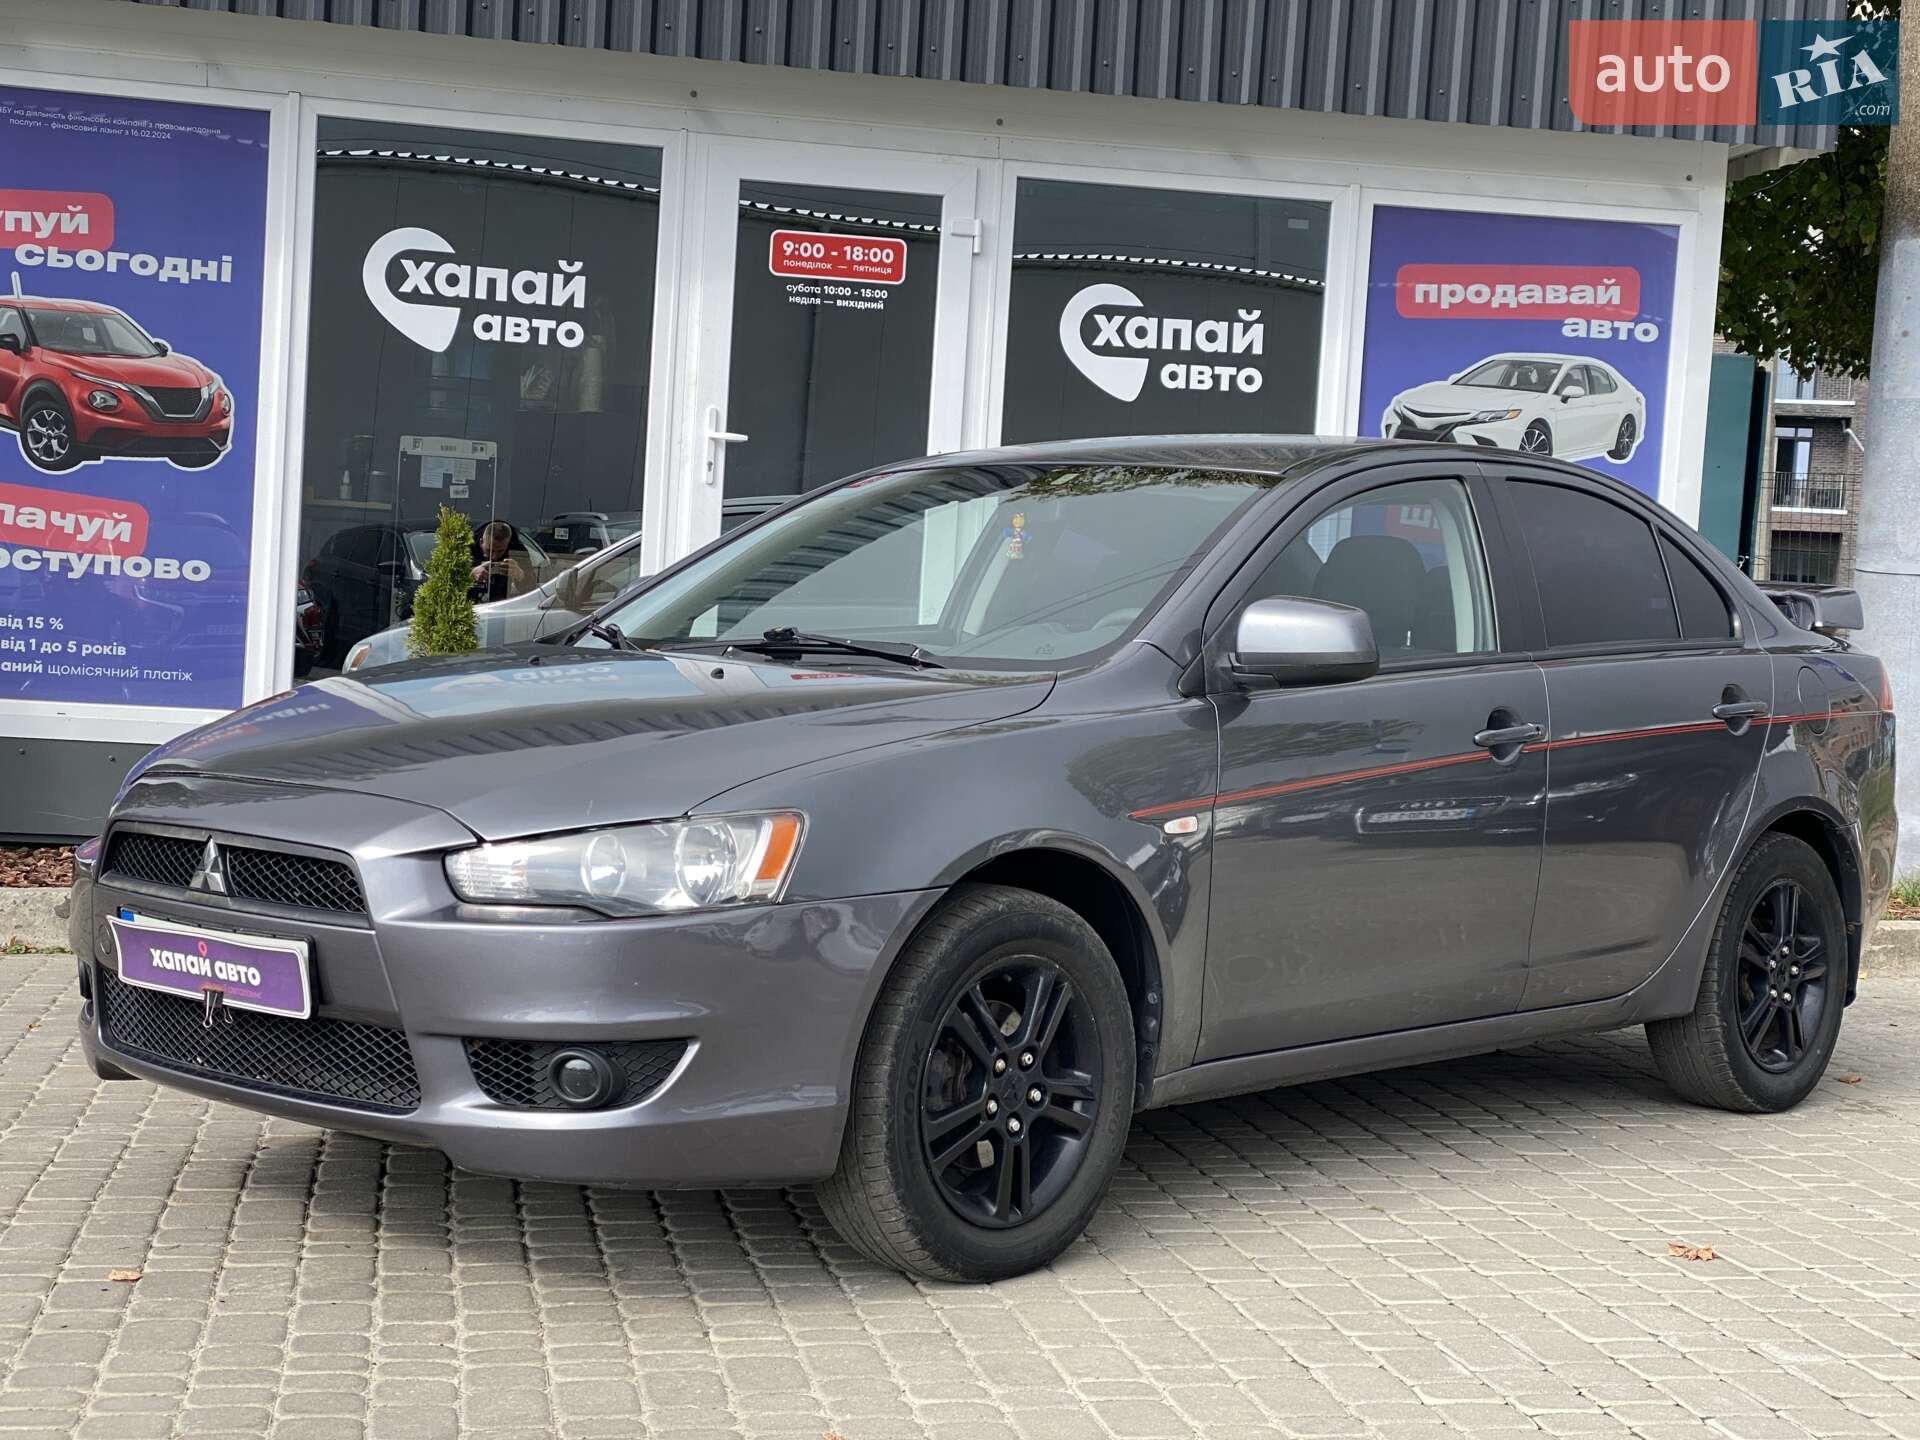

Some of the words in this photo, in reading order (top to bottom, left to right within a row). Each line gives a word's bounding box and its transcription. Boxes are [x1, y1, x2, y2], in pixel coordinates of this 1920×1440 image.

[0, 205, 89, 239] пуй
[15, 243, 233, 284] сьогодні
[782, 241, 825, 258] 9:00
[843, 245, 894, 264] 18:00
[783, 259, 833, 270] понеділок
[398, 259, 586, 308] хапай
[786, 284, 821, 296] субота
[823, 285, 851, 296] 10:00
[861, 288, 888, 299] 15:00
[1415, 278, 1621, 309] продавай
[789, 295, 821, 305] неділя
[836, 299, 884, 310] вихідний
[473, 313, 584, 348] авто
[1092, 309, 1264, 355] хапай
[1561, 317, 1659, 342] авто
[1160, 363, 1263, 393] авто
[27, 616, 44, 629] 15
[1, 637, 25, 652] від
[29, 638, 36, 651] 1
[41, 641, 62, 653] до
[67, 641, 77, 652] 5
[82, 642, 127, 656] років
[48, 664, 139, 678] щомісячний
[143, 668, 192, 681] платіж
[214, 960, 261, 986] авто
